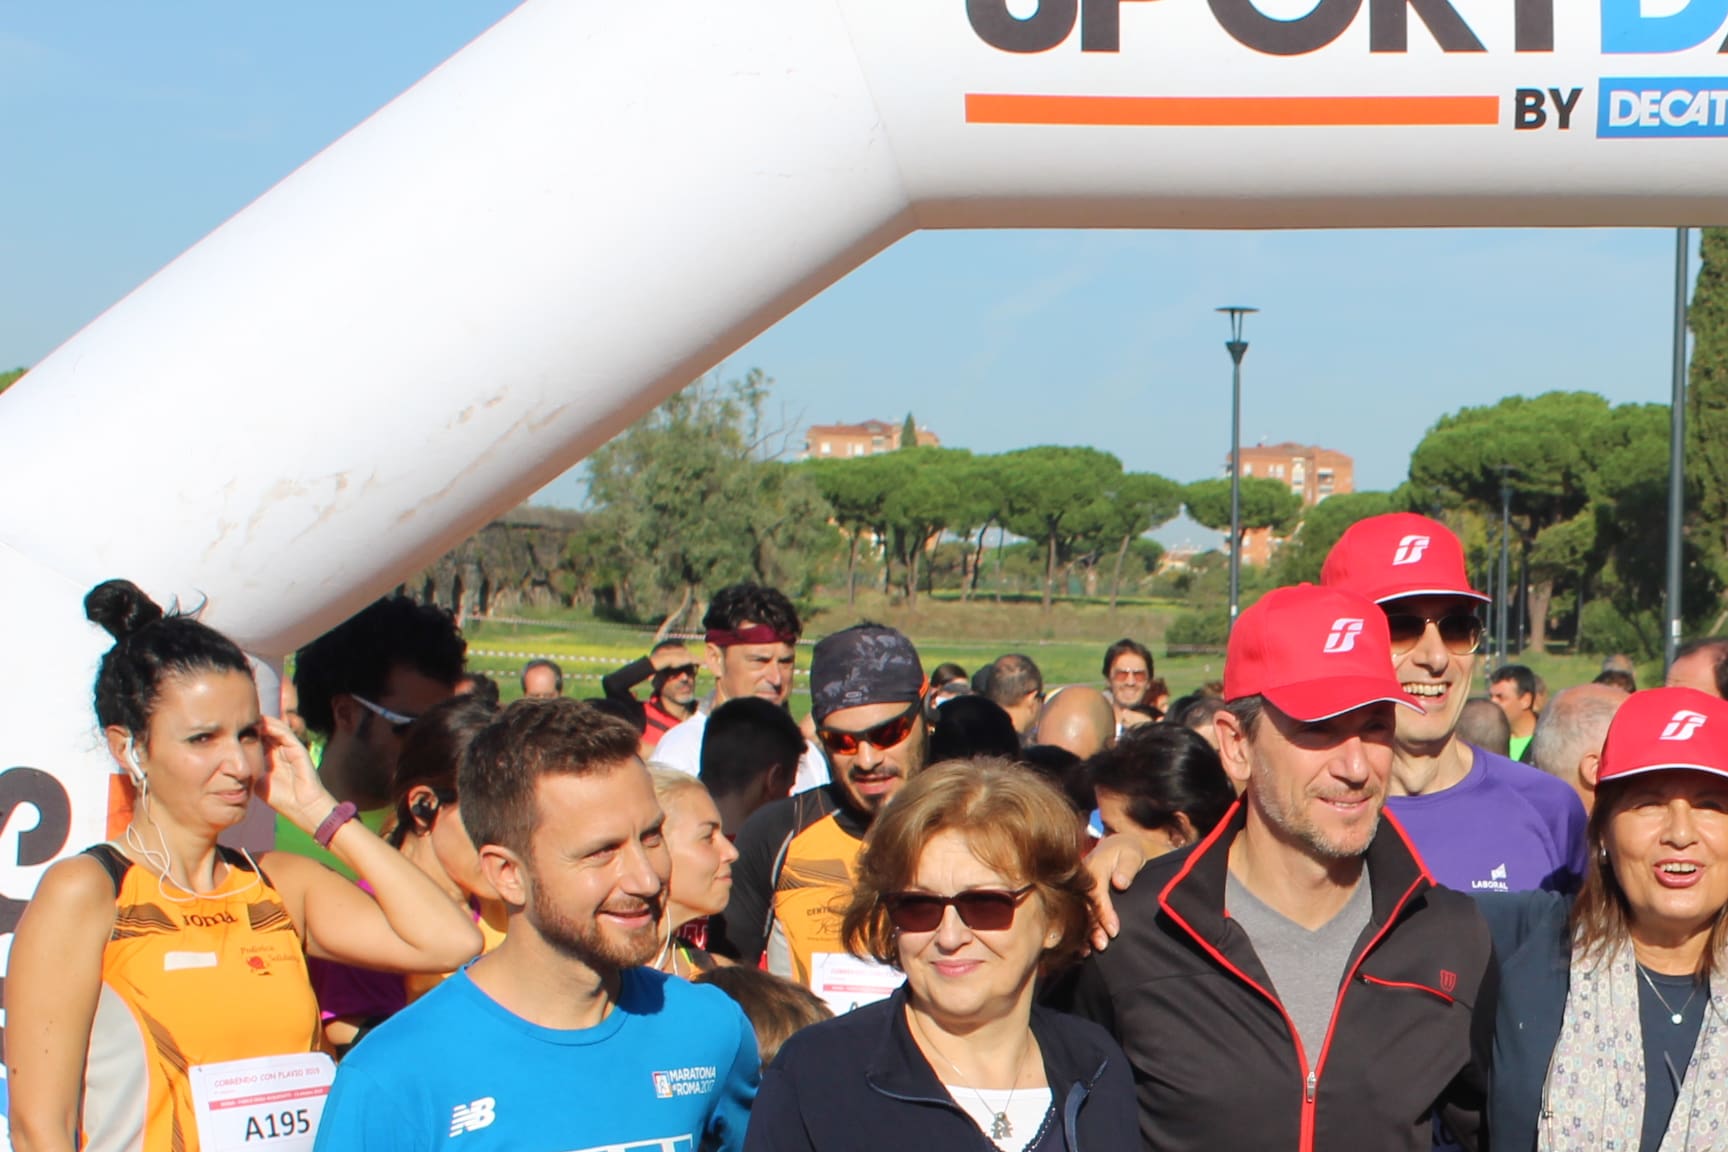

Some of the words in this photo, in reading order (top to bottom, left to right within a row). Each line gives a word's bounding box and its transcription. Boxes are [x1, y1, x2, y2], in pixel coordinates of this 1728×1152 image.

[1514, 88, 1583, 131] BY
[1471, 880, 1509, 890] LABORAL
[669, 1065, 717, 1082] MARATONA
[245, 1109, 311, 1141] A195
